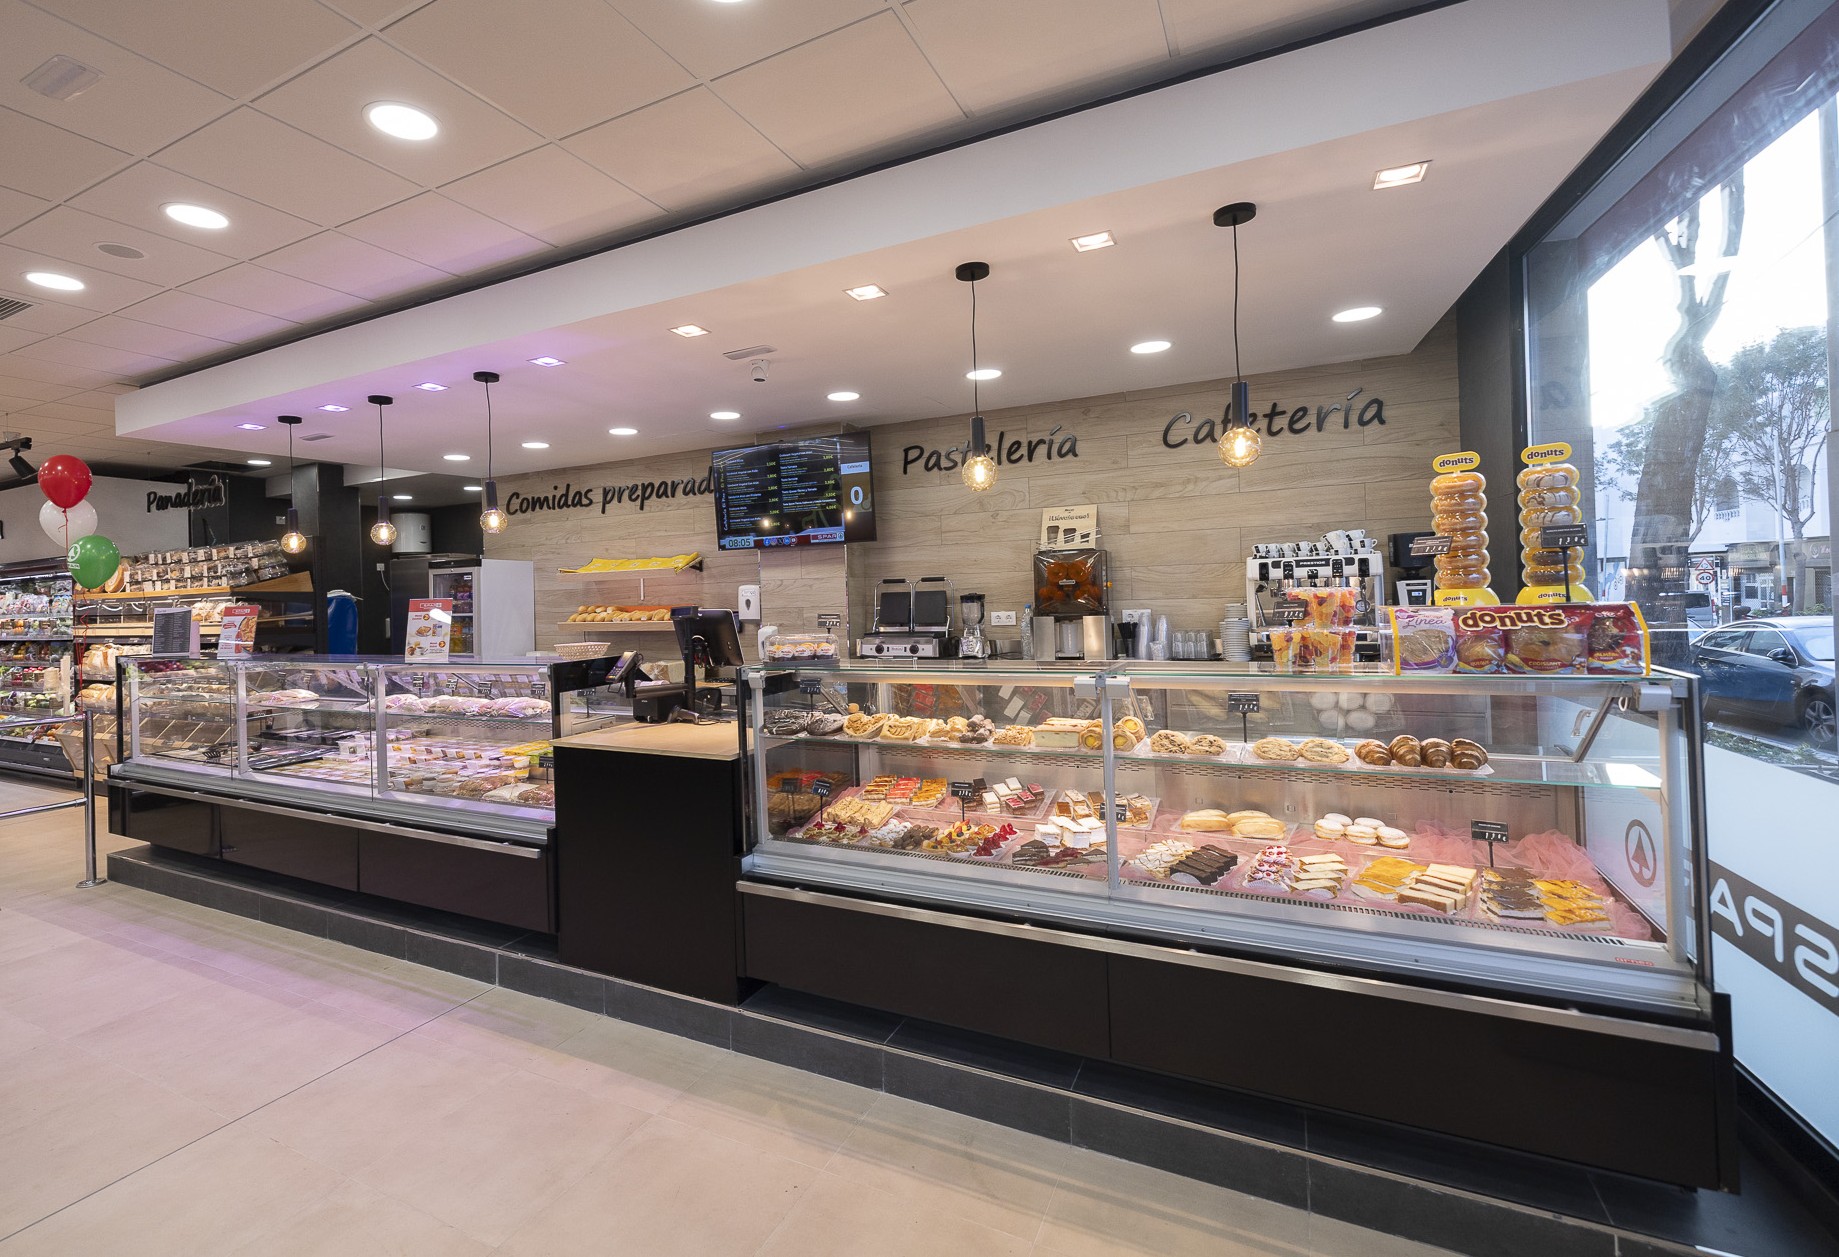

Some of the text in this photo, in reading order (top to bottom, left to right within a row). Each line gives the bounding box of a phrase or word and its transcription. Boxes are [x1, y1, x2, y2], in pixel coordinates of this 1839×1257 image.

[1438, 456, 1474, 468] donuts
[1526, 448, 1564, 460] donuts
[146, 475, 223, 513] Panadería
[506, 483, 594, 516] Comidas
[850, 485, 864, 505] 0
[728, 538, 751, 548] 08:05
[1460, 609, 1567, 630] donuts
